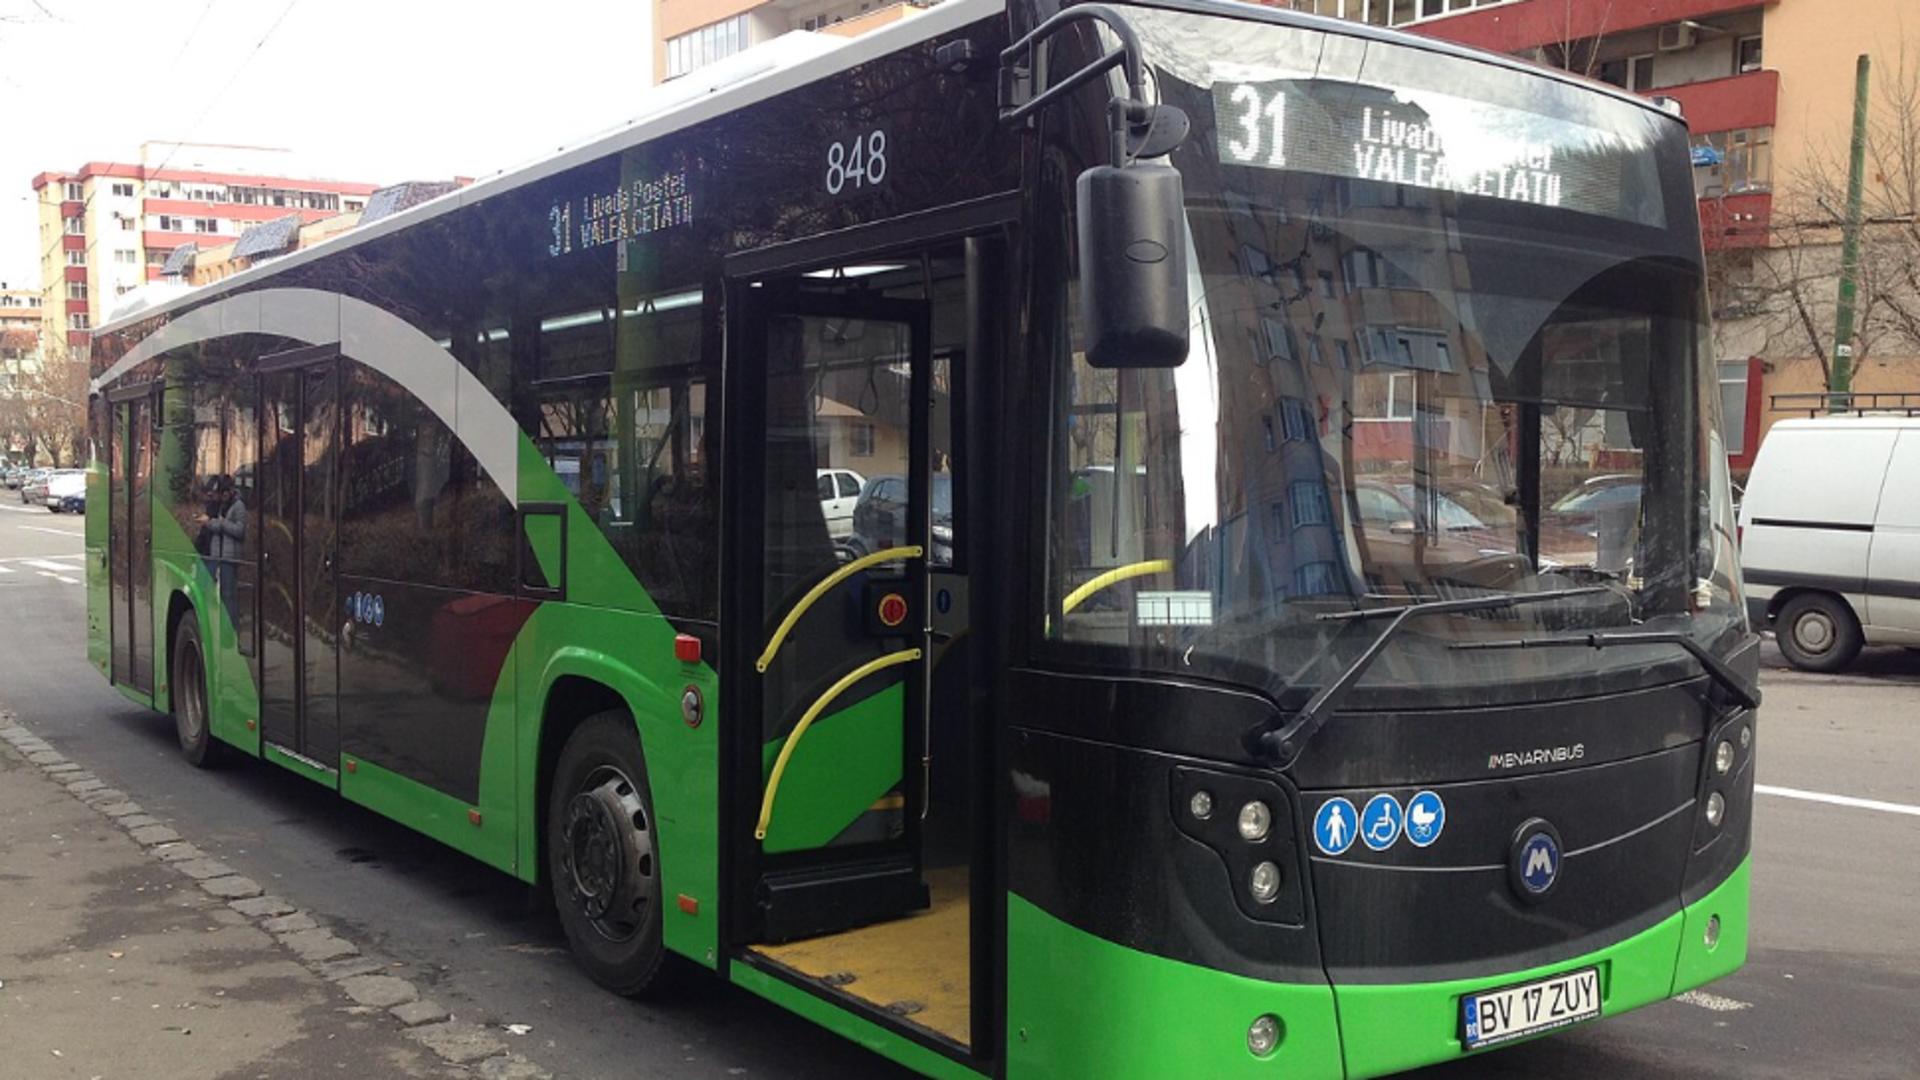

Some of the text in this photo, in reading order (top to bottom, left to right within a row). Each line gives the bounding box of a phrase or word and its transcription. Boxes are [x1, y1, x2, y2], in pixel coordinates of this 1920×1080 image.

[1229, 84, 1286, 166] 31
[826, 129, 886, 195] 848
[1354, 143, 1453, 190] VALEA
[550, 201, 571, 257] 31
[580, 212, 628, 249] VALEA
[1525, 847, 1552, 877] M
[1480, 994, 1513, 1035] BV
[1522, 986, 1543, 1023] 17
[1549, 974, 1594, 1016] ZUY
